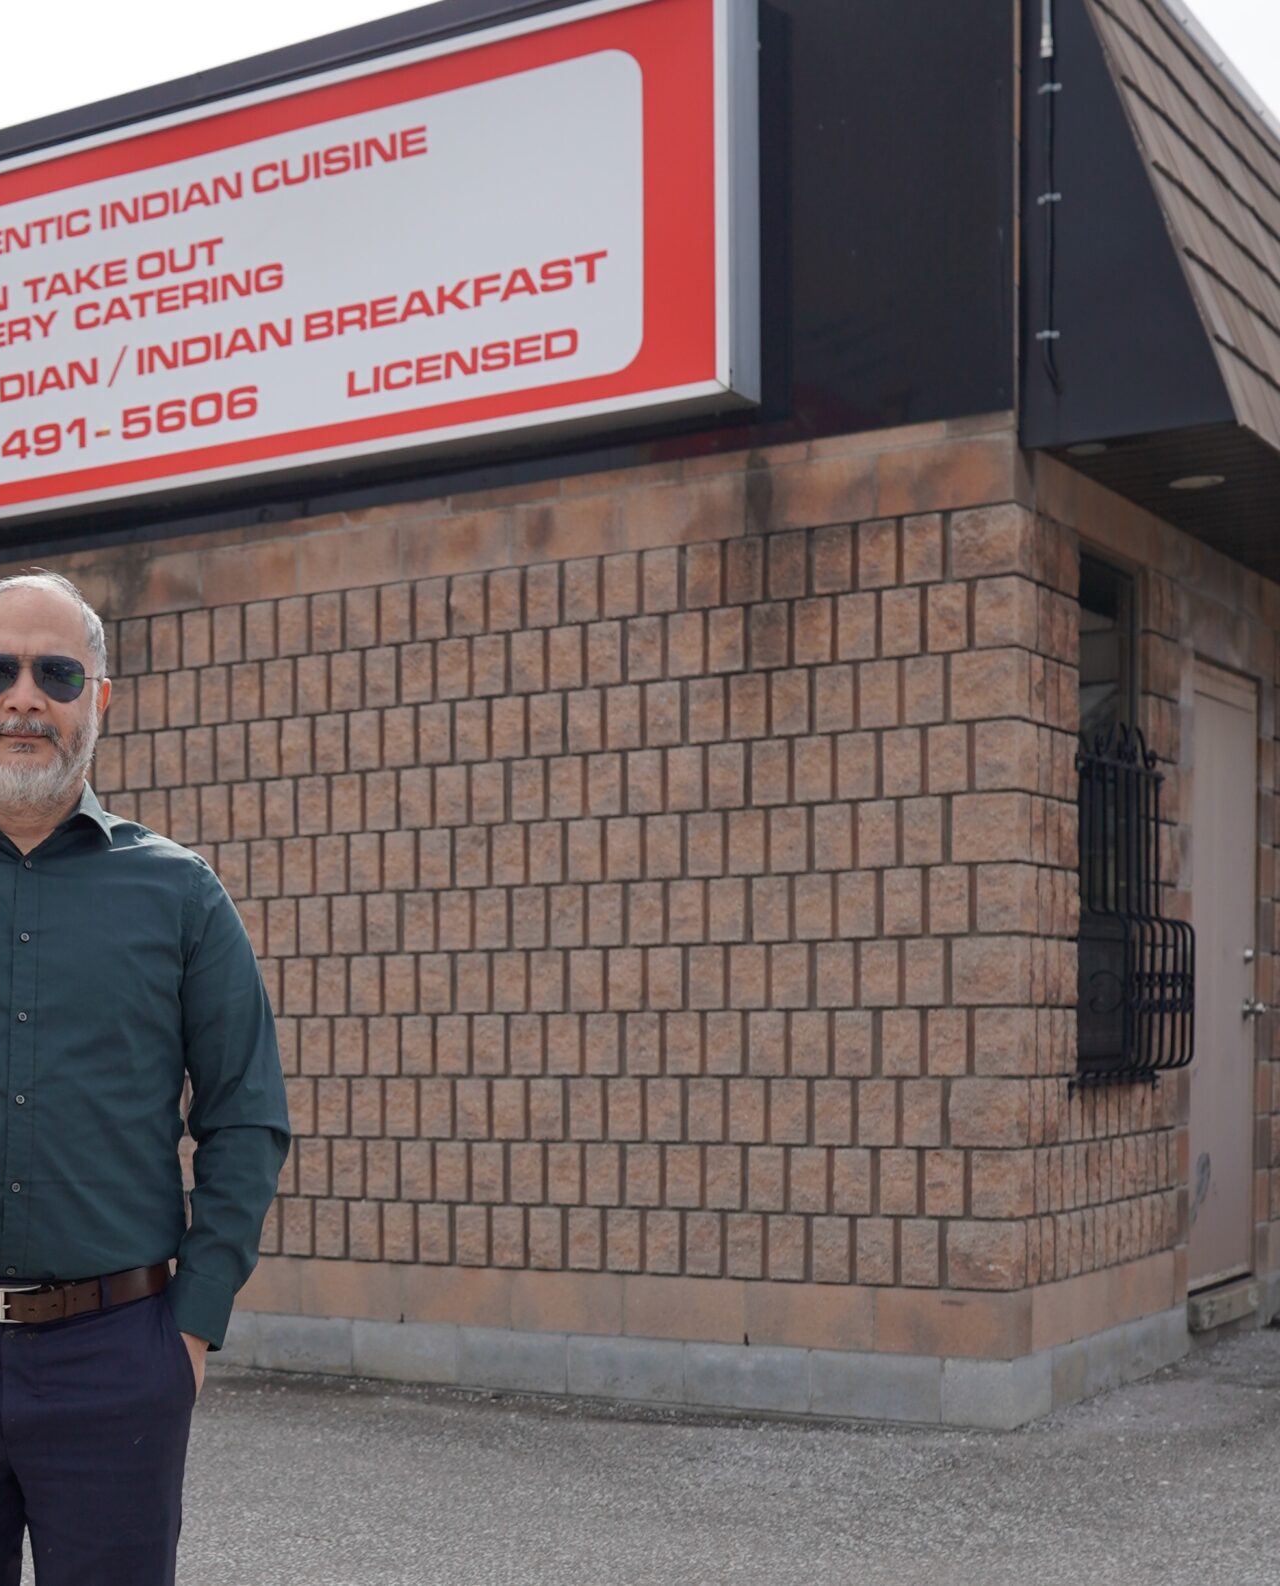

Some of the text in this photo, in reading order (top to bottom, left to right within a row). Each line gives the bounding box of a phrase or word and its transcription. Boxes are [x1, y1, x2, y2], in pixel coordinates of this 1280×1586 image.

[100, 171, 244, 231] INDIAN
[251, 125, 428, 194] CUISINE
[22, 258, 129, 304] TAKE
[136, 237, 224, 281] OUT
[74, 262, 284, 331] CATERING
[136, 317, 293, 376] INDIAN
[303, 249, 609, 343] BREAKFAST
[346, 327, 579, 398] LICENSED
